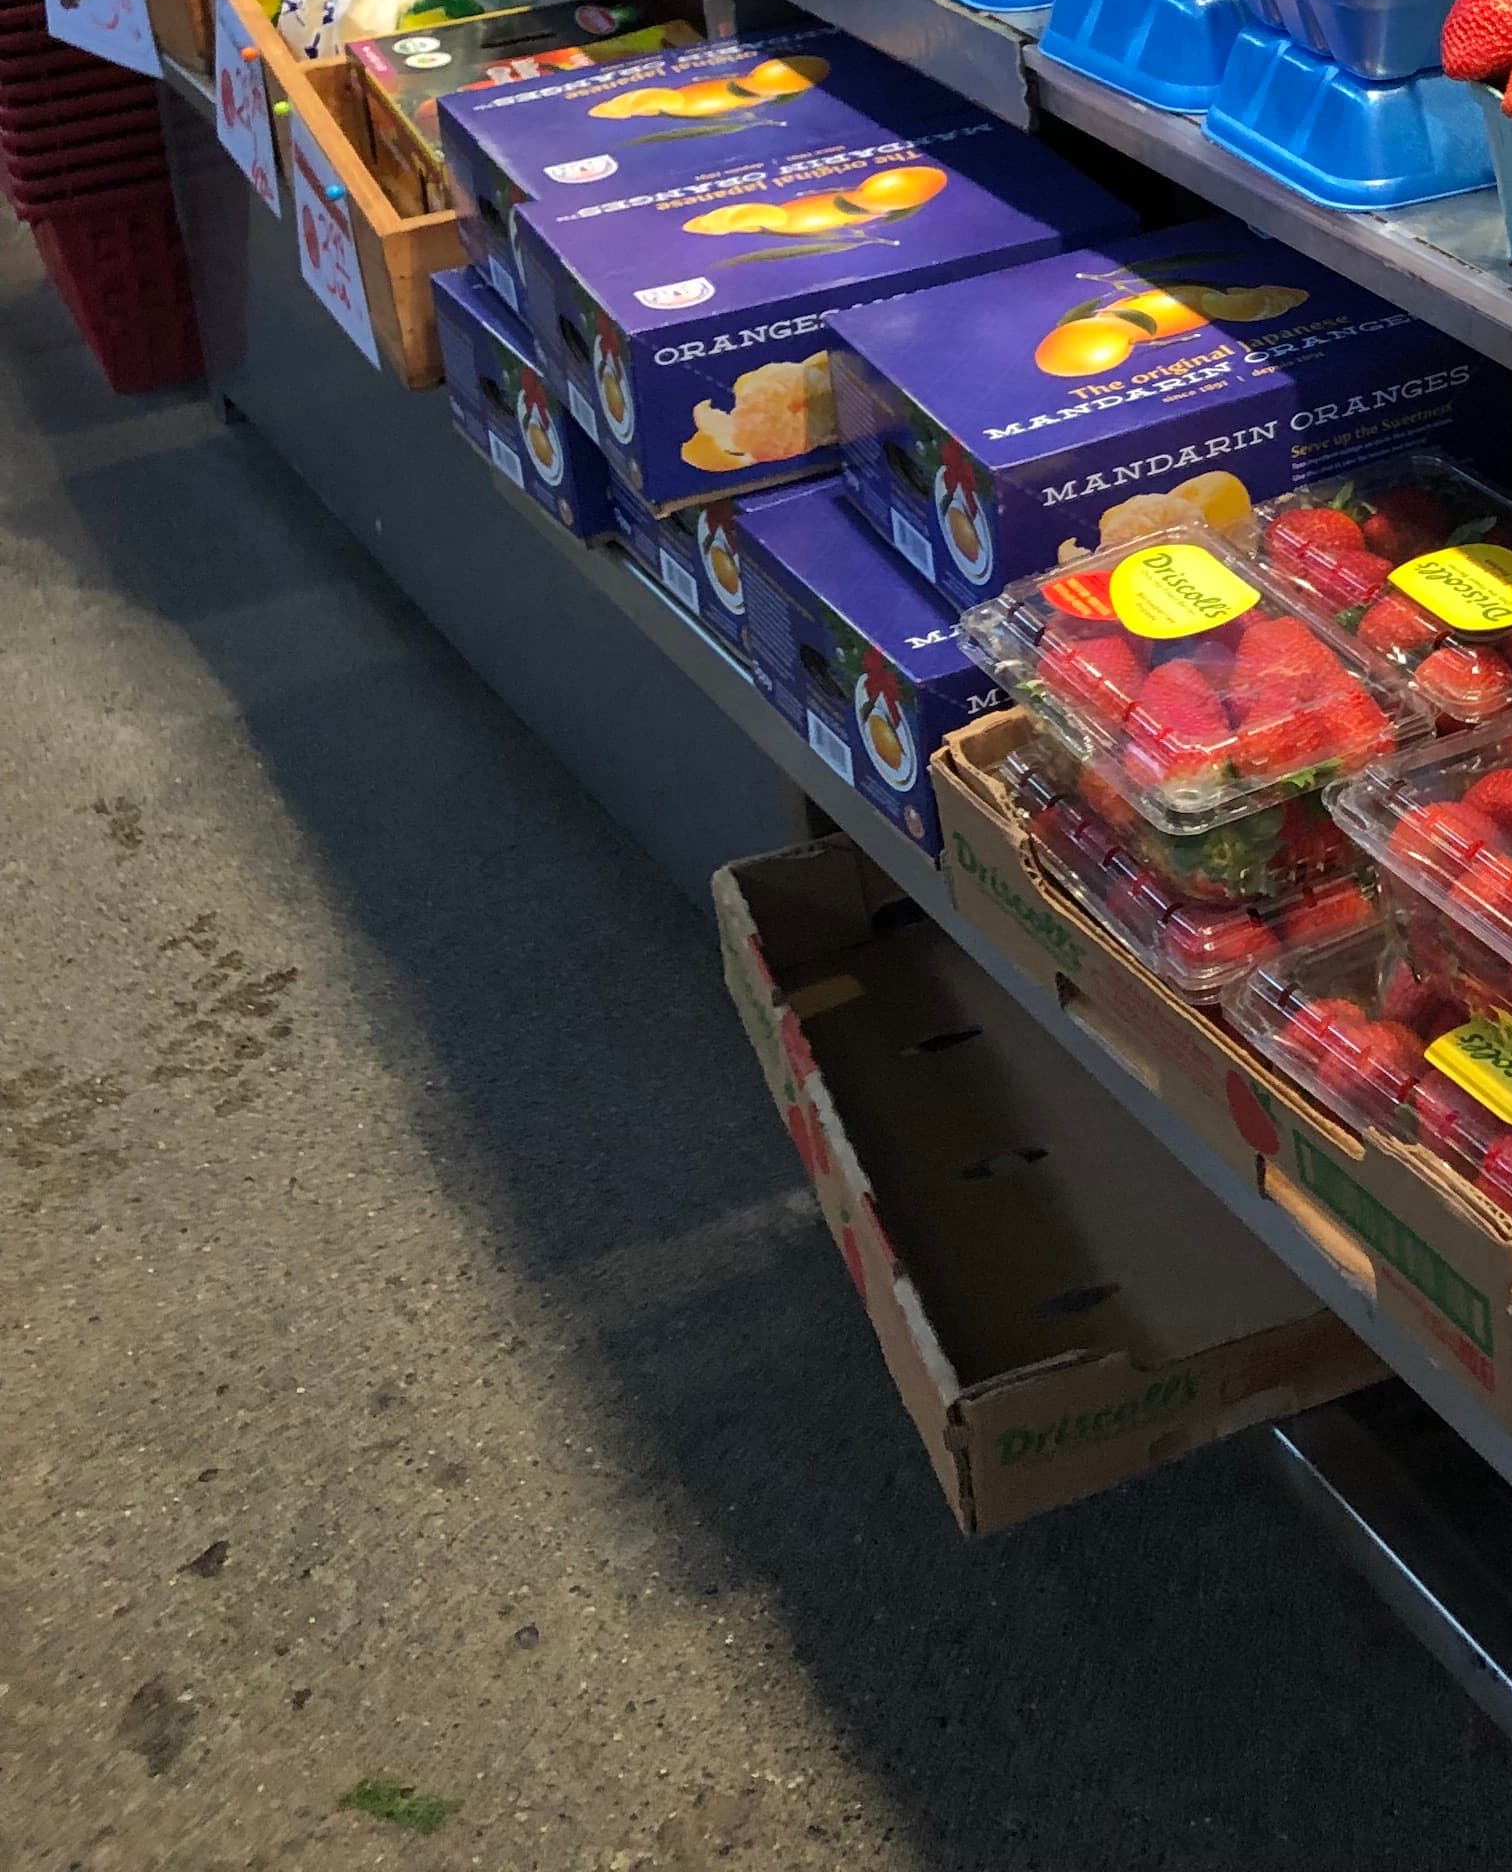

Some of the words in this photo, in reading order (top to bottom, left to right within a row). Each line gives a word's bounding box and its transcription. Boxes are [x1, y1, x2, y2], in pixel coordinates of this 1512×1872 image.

[655, 179, 768, 212] Japanese
[772, 159, 869, 188] original
[982, 360, 1233, 441] MANDARIN
[1244, 312, 1420, 364] ORANGE
[1068, 377, 1125, 400] The
[1130, 344, 1236, 385] original
[1238, 314, 1349, 353] Japanese
[1161, 388, 1196, 403] since
[1251, 358, 1296, 378] depuis
[1042, 419, 1278, 507] MANDARIN
[1289, 364, 1472, 432] ORANGES
[1290, 438, 1330, 458] Serve
[1333, 431, 1351, 447] up
[1355, 422, 1379, 439] the
[1142, 552, 1230, 620] Driscoll's
[1415, 560, 1512, 623] Driscoll's
